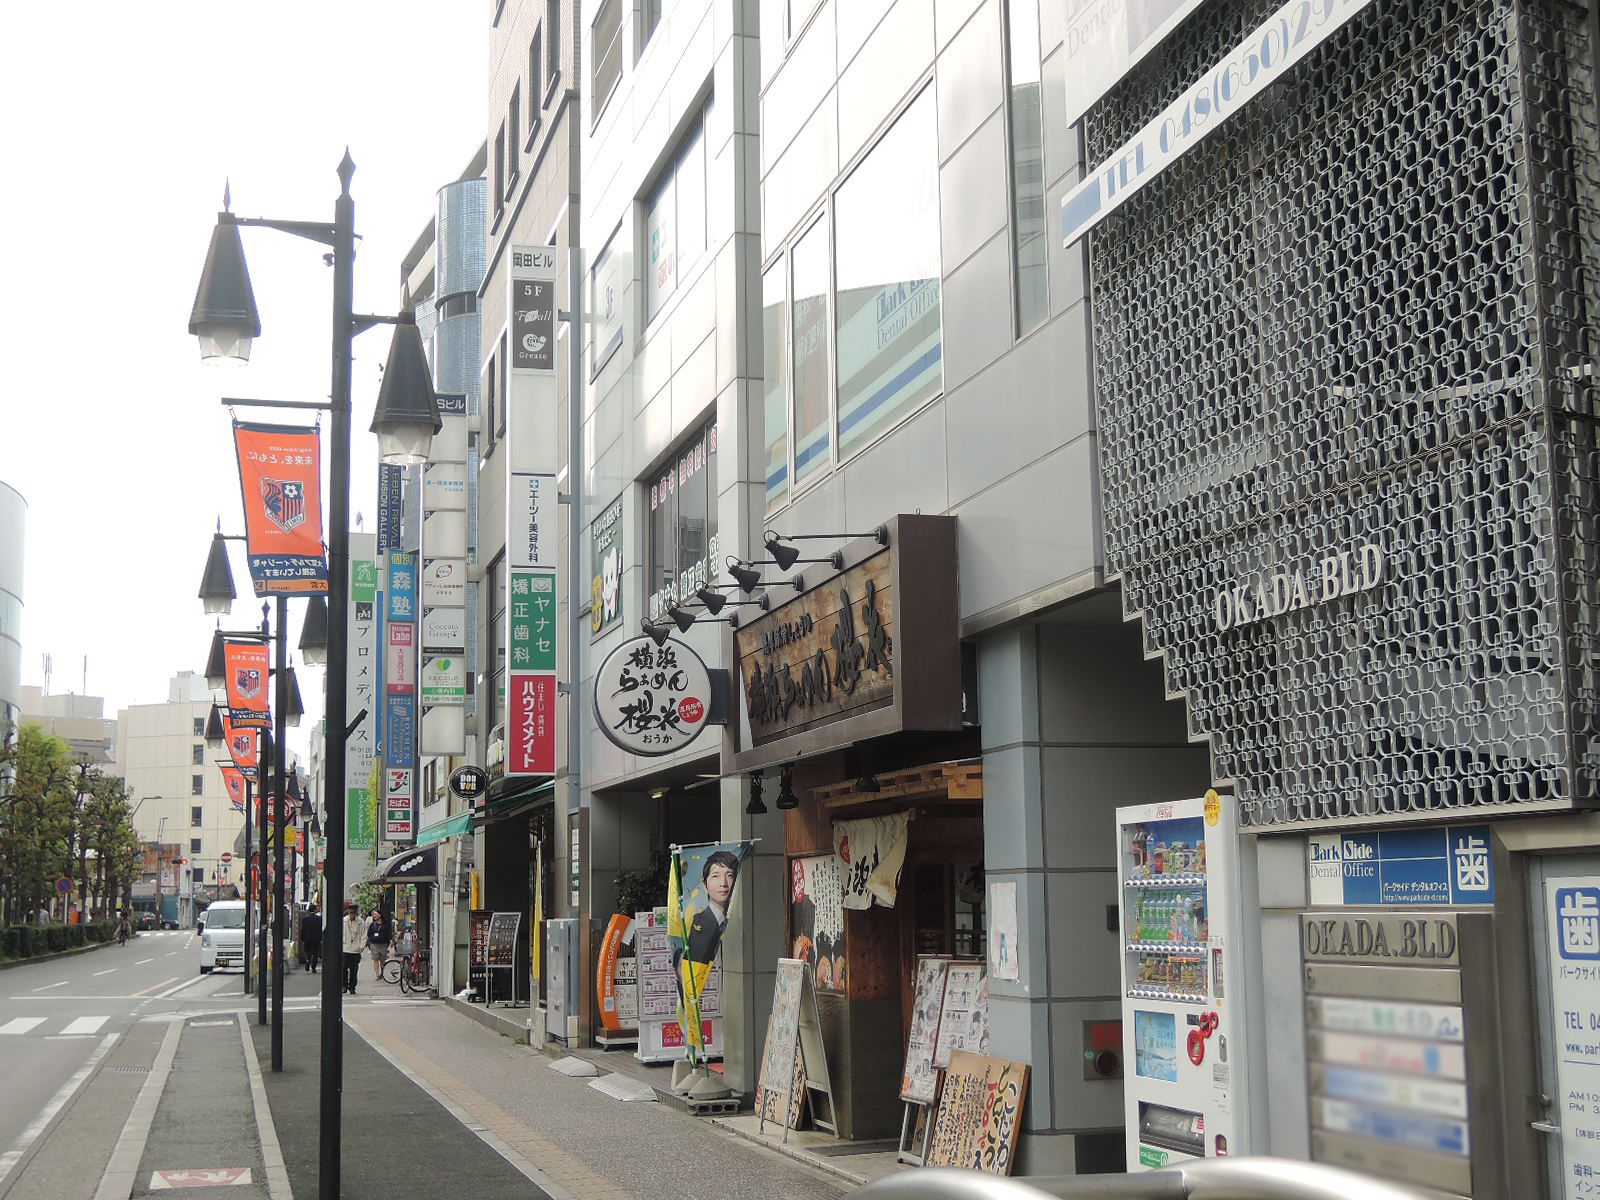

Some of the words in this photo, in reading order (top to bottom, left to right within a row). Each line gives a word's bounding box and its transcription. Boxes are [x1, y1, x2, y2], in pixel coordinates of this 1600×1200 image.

[1099, 141, 1152, 200] TEL
[1159, 0, 1352, 155] 048(650)29
[513, 252, 553, 268] 岡田ビル
[524, 285, 543, 296] 5F
[519, 351, 548, 360] Grease
[381, 465, 390, 507] MANSION
[528, 489, 539, 563] エーツー美容外科
[392, 570, 411, 616] 森塾
[392, 631, 410, 641] Labo
[512, 578, 530, 665] 矯正歯科
[533, 596, 551, 653] ヤナセ
[624, 642, 678, 669] 横浜
[356, 626, 372, 741] プロメディス
[521, 681, 535, 769] ハウスメイト
[642, 734, 673, 744] おうか
[389, 799, 410, 807] たばこ
[1310, 842, 1341, 862] Park
[1344, 840, 1374, 860] Side
[1454, 835, 1490, 892] 歯
[1310, 863, 1341, 879] Dental
[1344, 863, 1374, 877] Office
[1305, 918, 1457, 960] OKADA.BLD
[1560, 891, 1599, 955] 歯
[1564, 1011, 1583, 1030] TEL
[1569, 1103, 1585, 1112] PM
